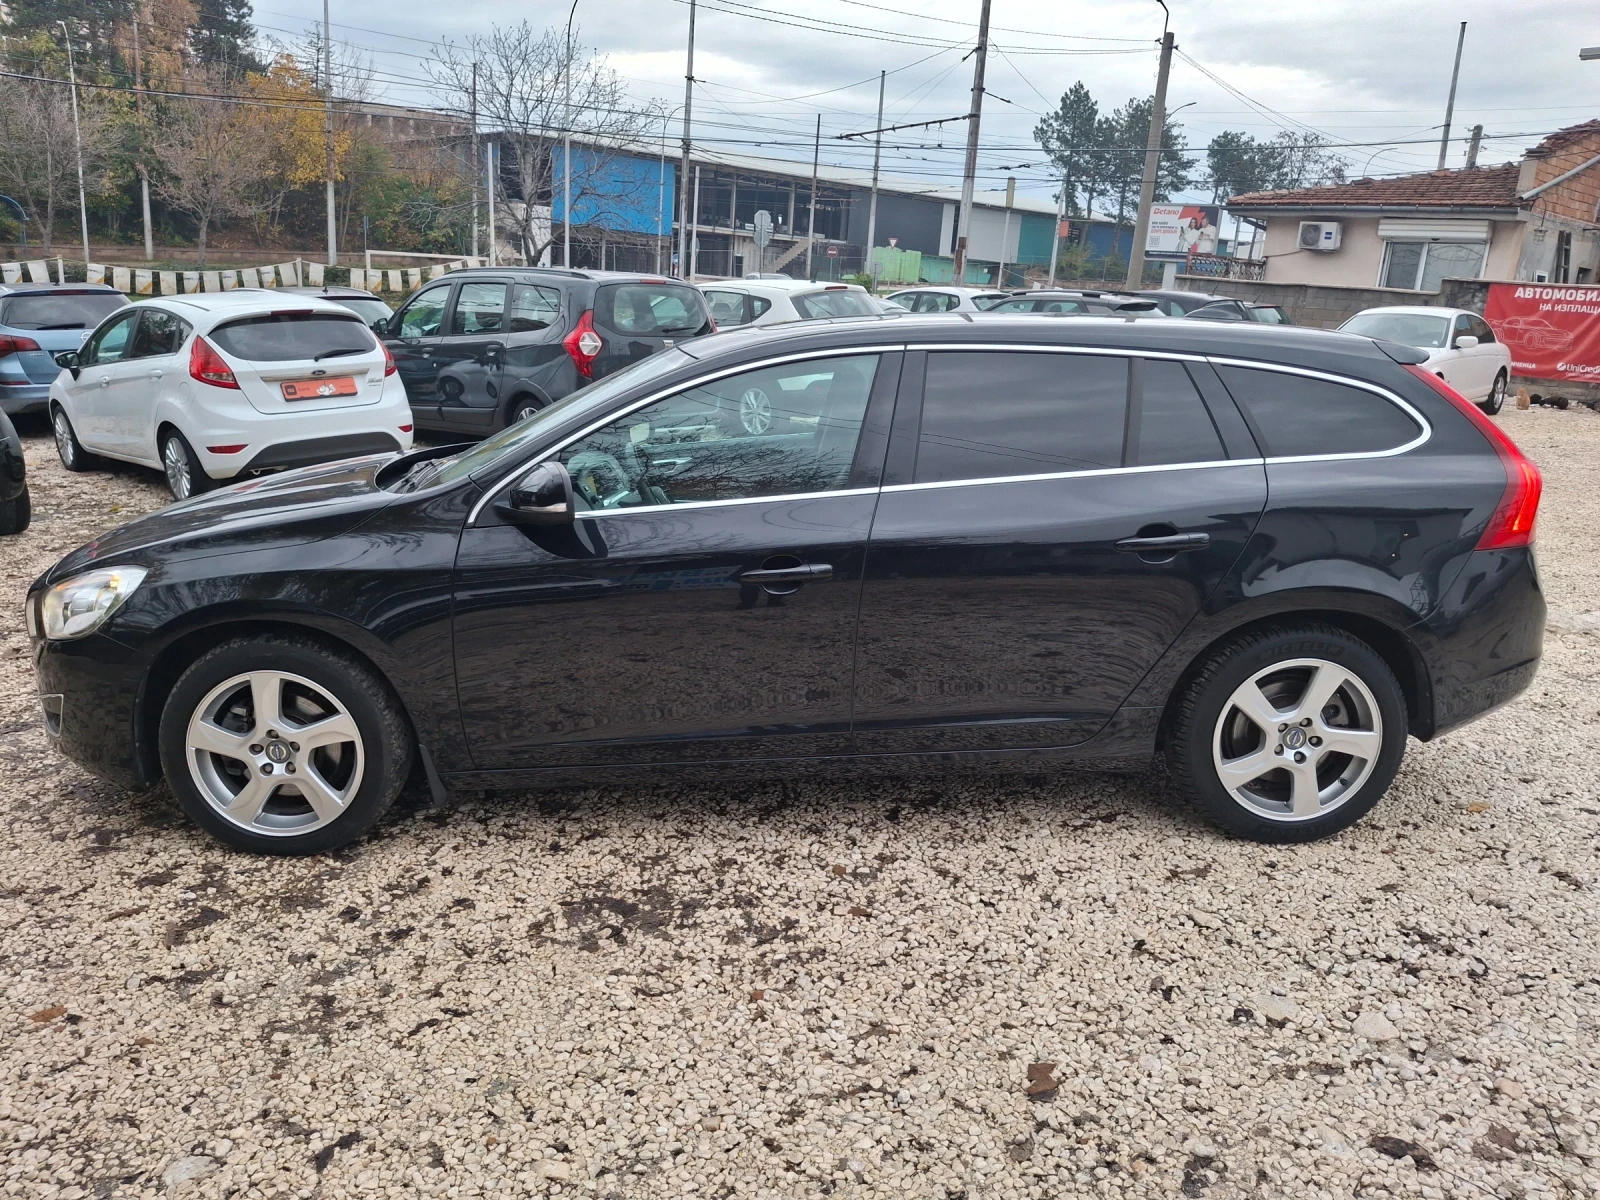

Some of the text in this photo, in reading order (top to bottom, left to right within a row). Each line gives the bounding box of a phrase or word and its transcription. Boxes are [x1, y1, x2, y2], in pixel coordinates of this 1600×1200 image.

[1153, 207, 1180, 216] Betano
[1539, 303, 1552, 311] НА
[1258, 641, 1341, 661] MICHELIN
